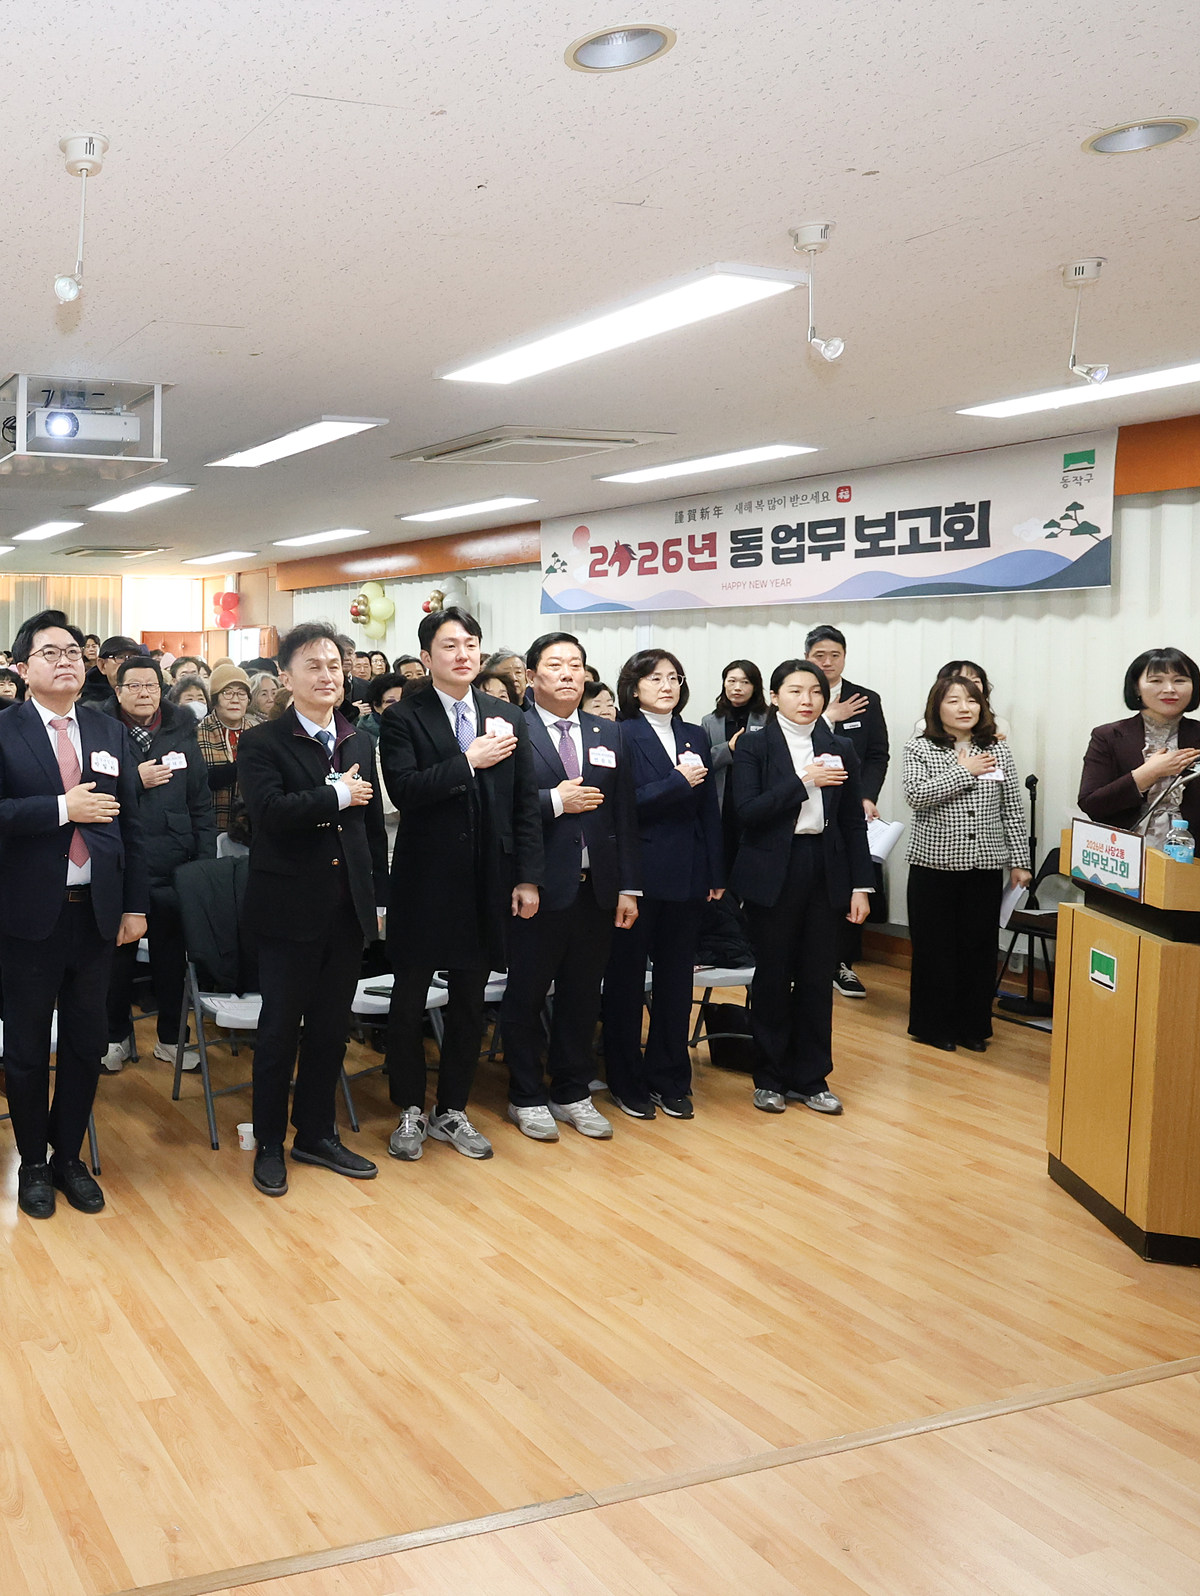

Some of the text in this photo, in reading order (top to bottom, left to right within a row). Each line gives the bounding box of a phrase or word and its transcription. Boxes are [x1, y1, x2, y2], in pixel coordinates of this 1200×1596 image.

[1060, 473, 1094, 489] 동작구
[734, 491, 831, 514] 새해 복 많이 받으세요
[674, 506, 724, 524] 謹賀新年
[589, 500, 991, 578] 226년 동 업무 보고회
[721, 578, 792, 591] HAPPY NEW YEAR
[1086, 840, 1126, 860] 2026년 사당2동
[1082, 849, 1130, 879] 업무보고회
